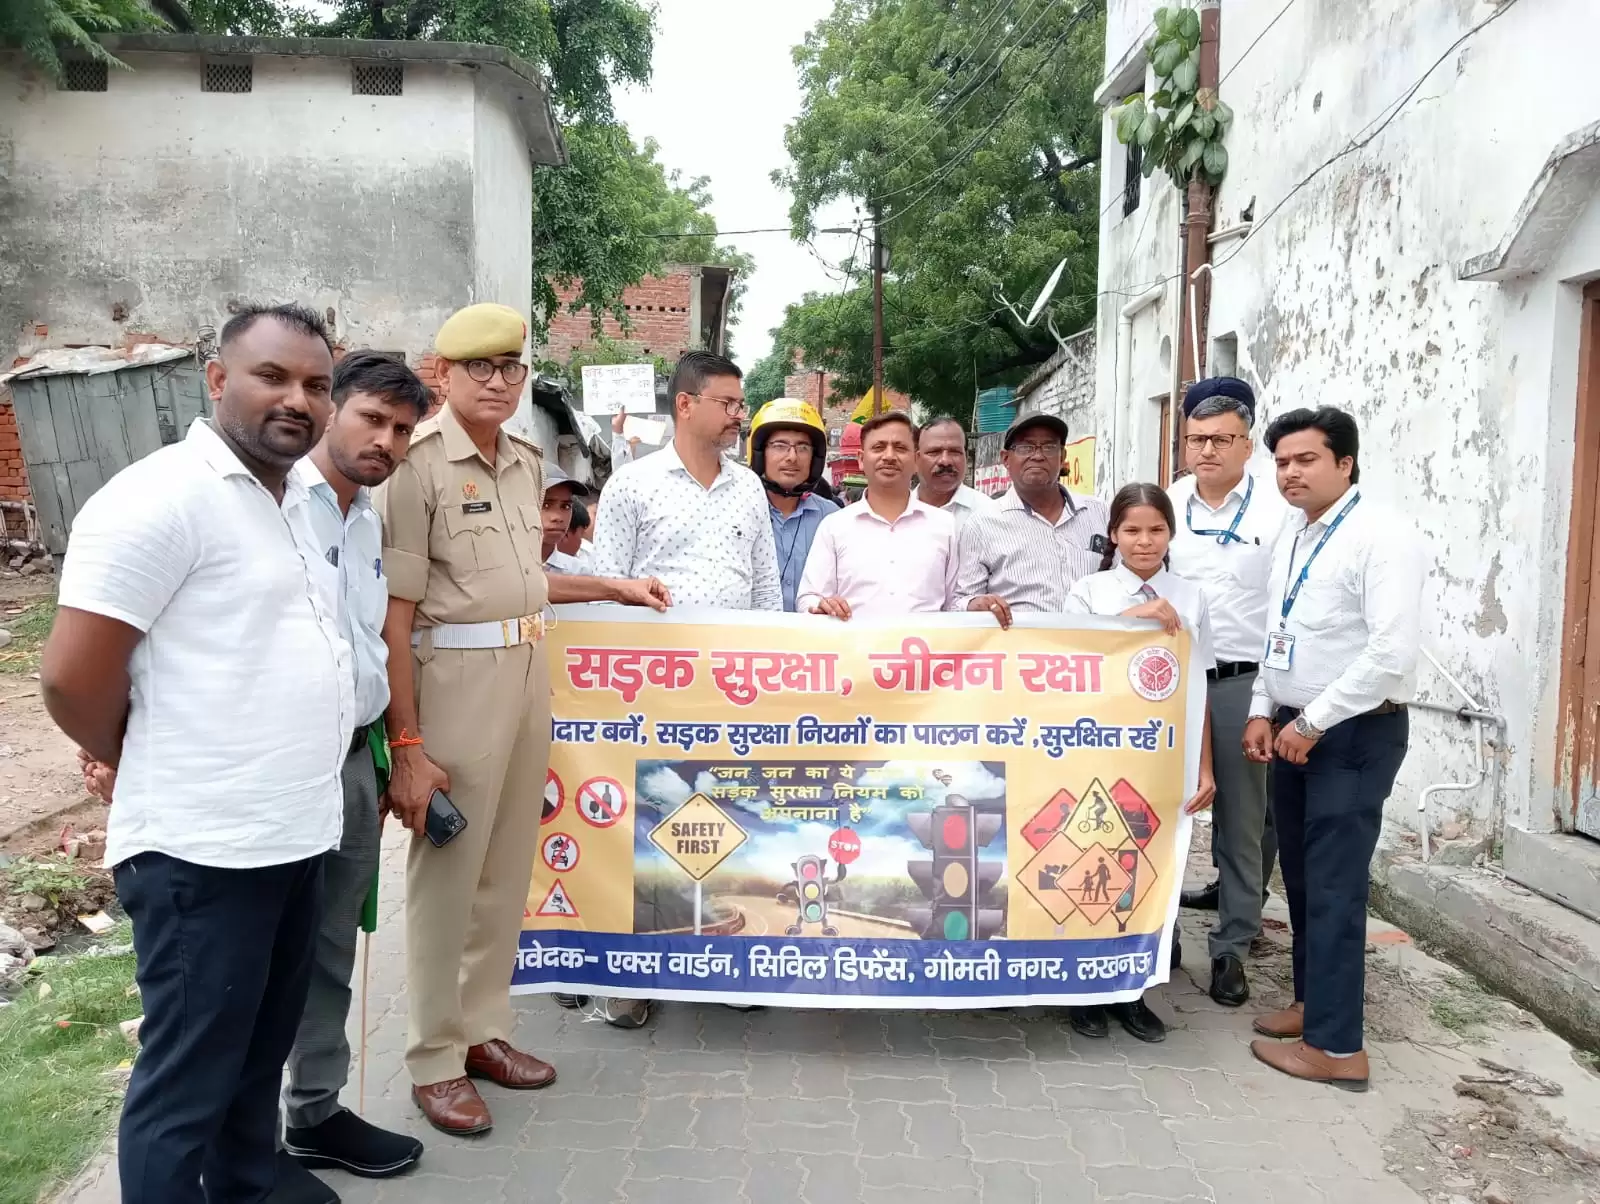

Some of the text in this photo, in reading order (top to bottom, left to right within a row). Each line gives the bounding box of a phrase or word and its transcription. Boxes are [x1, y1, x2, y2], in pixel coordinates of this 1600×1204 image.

[566, 637, 1104, 705] सड़क सुरक्षा, जीवन रक्षा
[601, 714, 648, 745] बनें,
[656, 723, 721, 751] सड़क
[727, 724, 790, 755] सुरक्षा
[797, 716, 871, 746] नियमों
[875, 724, 907, 745] का
[913, 724, 980, 746] पालन
[986, 718, 1028, 746] करें
[1129, 721, 1162, 750] रहें
[762, 766, 795, 779] जन
[805, 766, 829, 779] का
[839, 763, 856, 779] ये
[711, 782, 924, 805] सड़क सुरक्षा नियम को
[671, 822, 726, 838] SAFETY
[677, 840, 719, 855] FIRST
[830, 840, 859, 853] STOP
[605, 951, 663, 975] एक्स
[668, 944, 740, 980] वार्डन,
[749, 945, 829, 981] सिविल
[834, 947, 915, 984] डिफेंस,
[924, 949, 1002, 982] गोमती
[1007, 957, 1069, 982] नगर,
